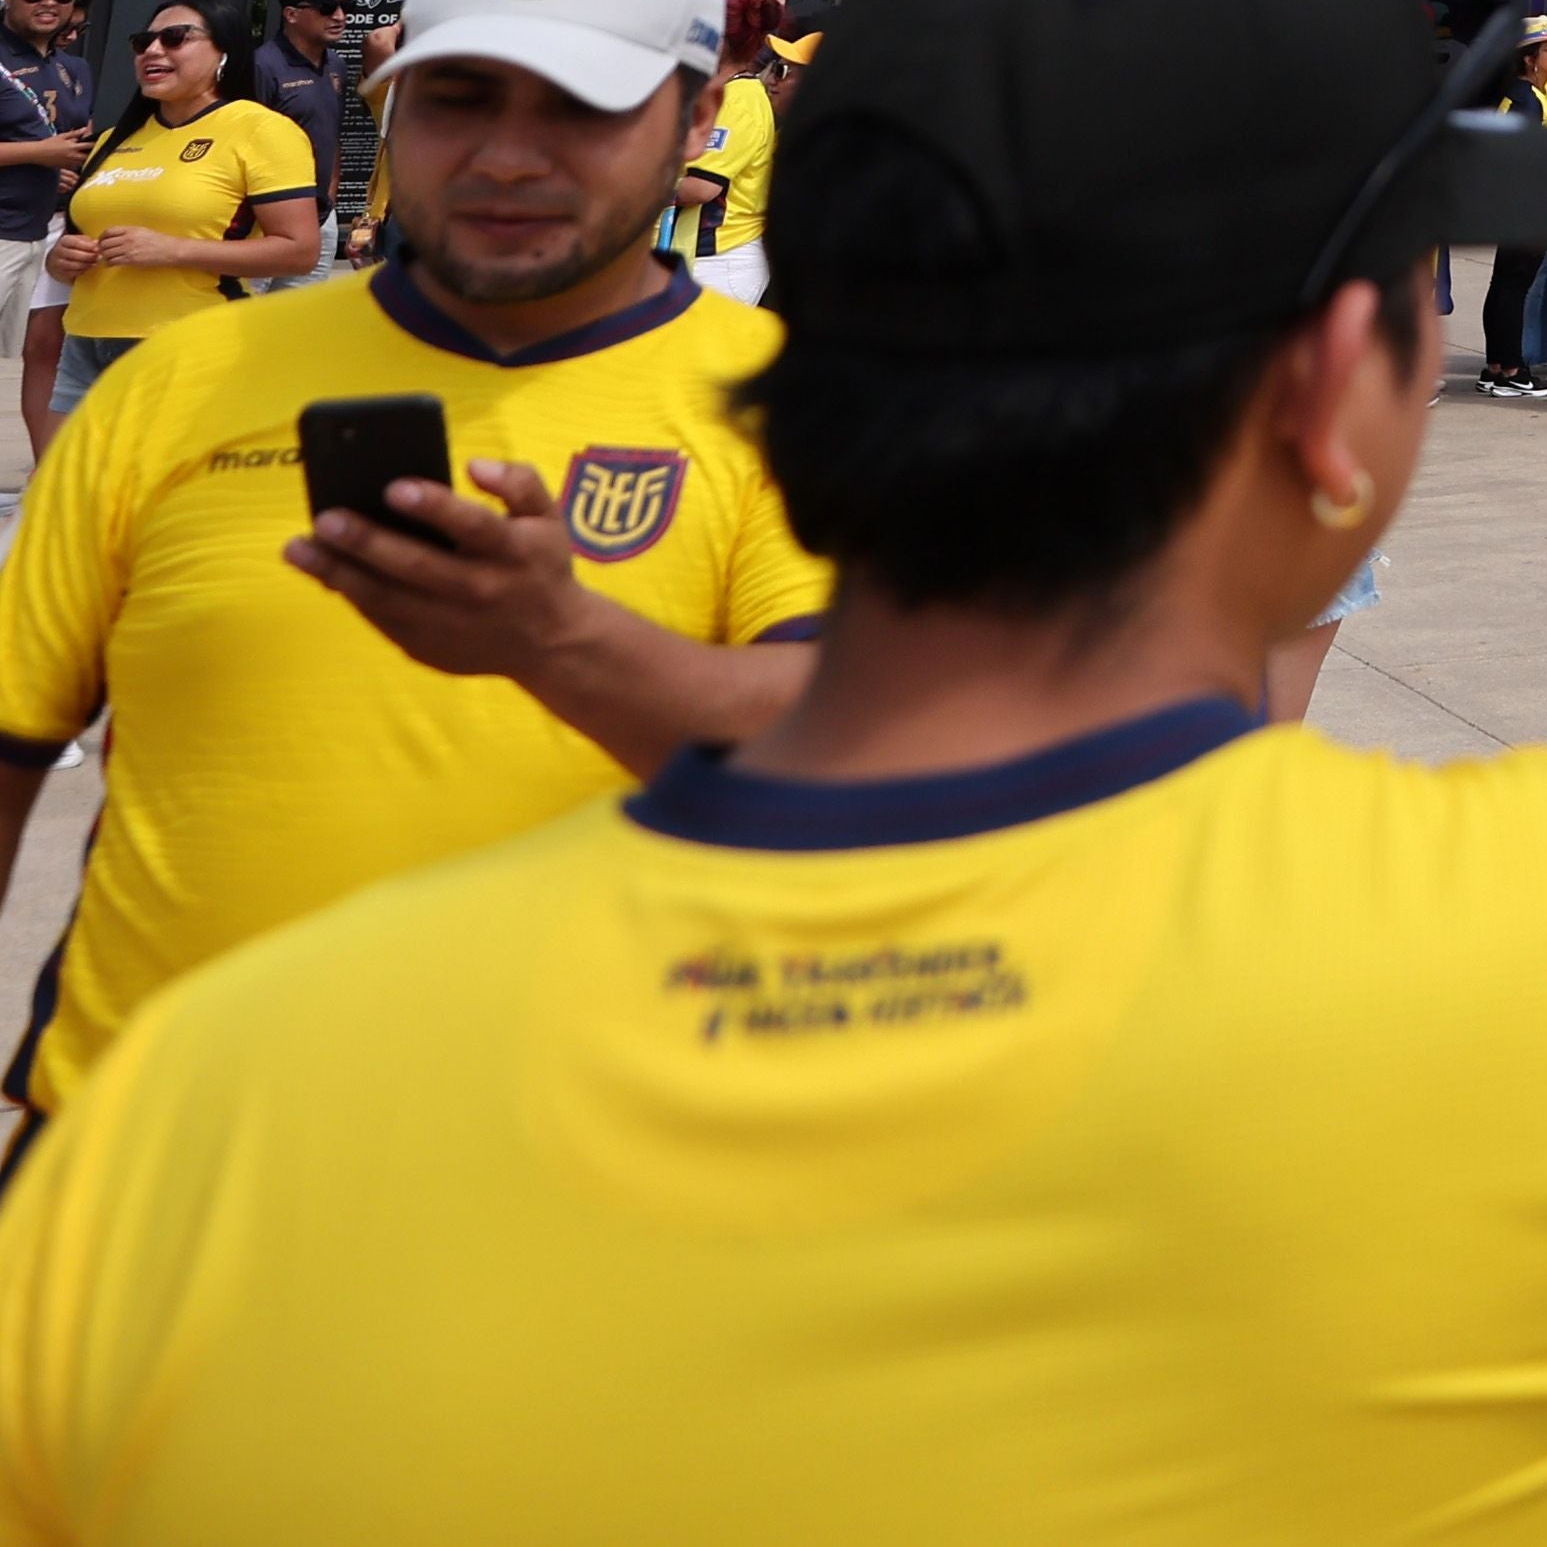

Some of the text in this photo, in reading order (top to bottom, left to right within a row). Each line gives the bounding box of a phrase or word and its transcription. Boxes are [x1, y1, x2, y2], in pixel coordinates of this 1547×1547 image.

[345, 14, 398, 24] ODE OF
[208, 445, 302, 473] mara
